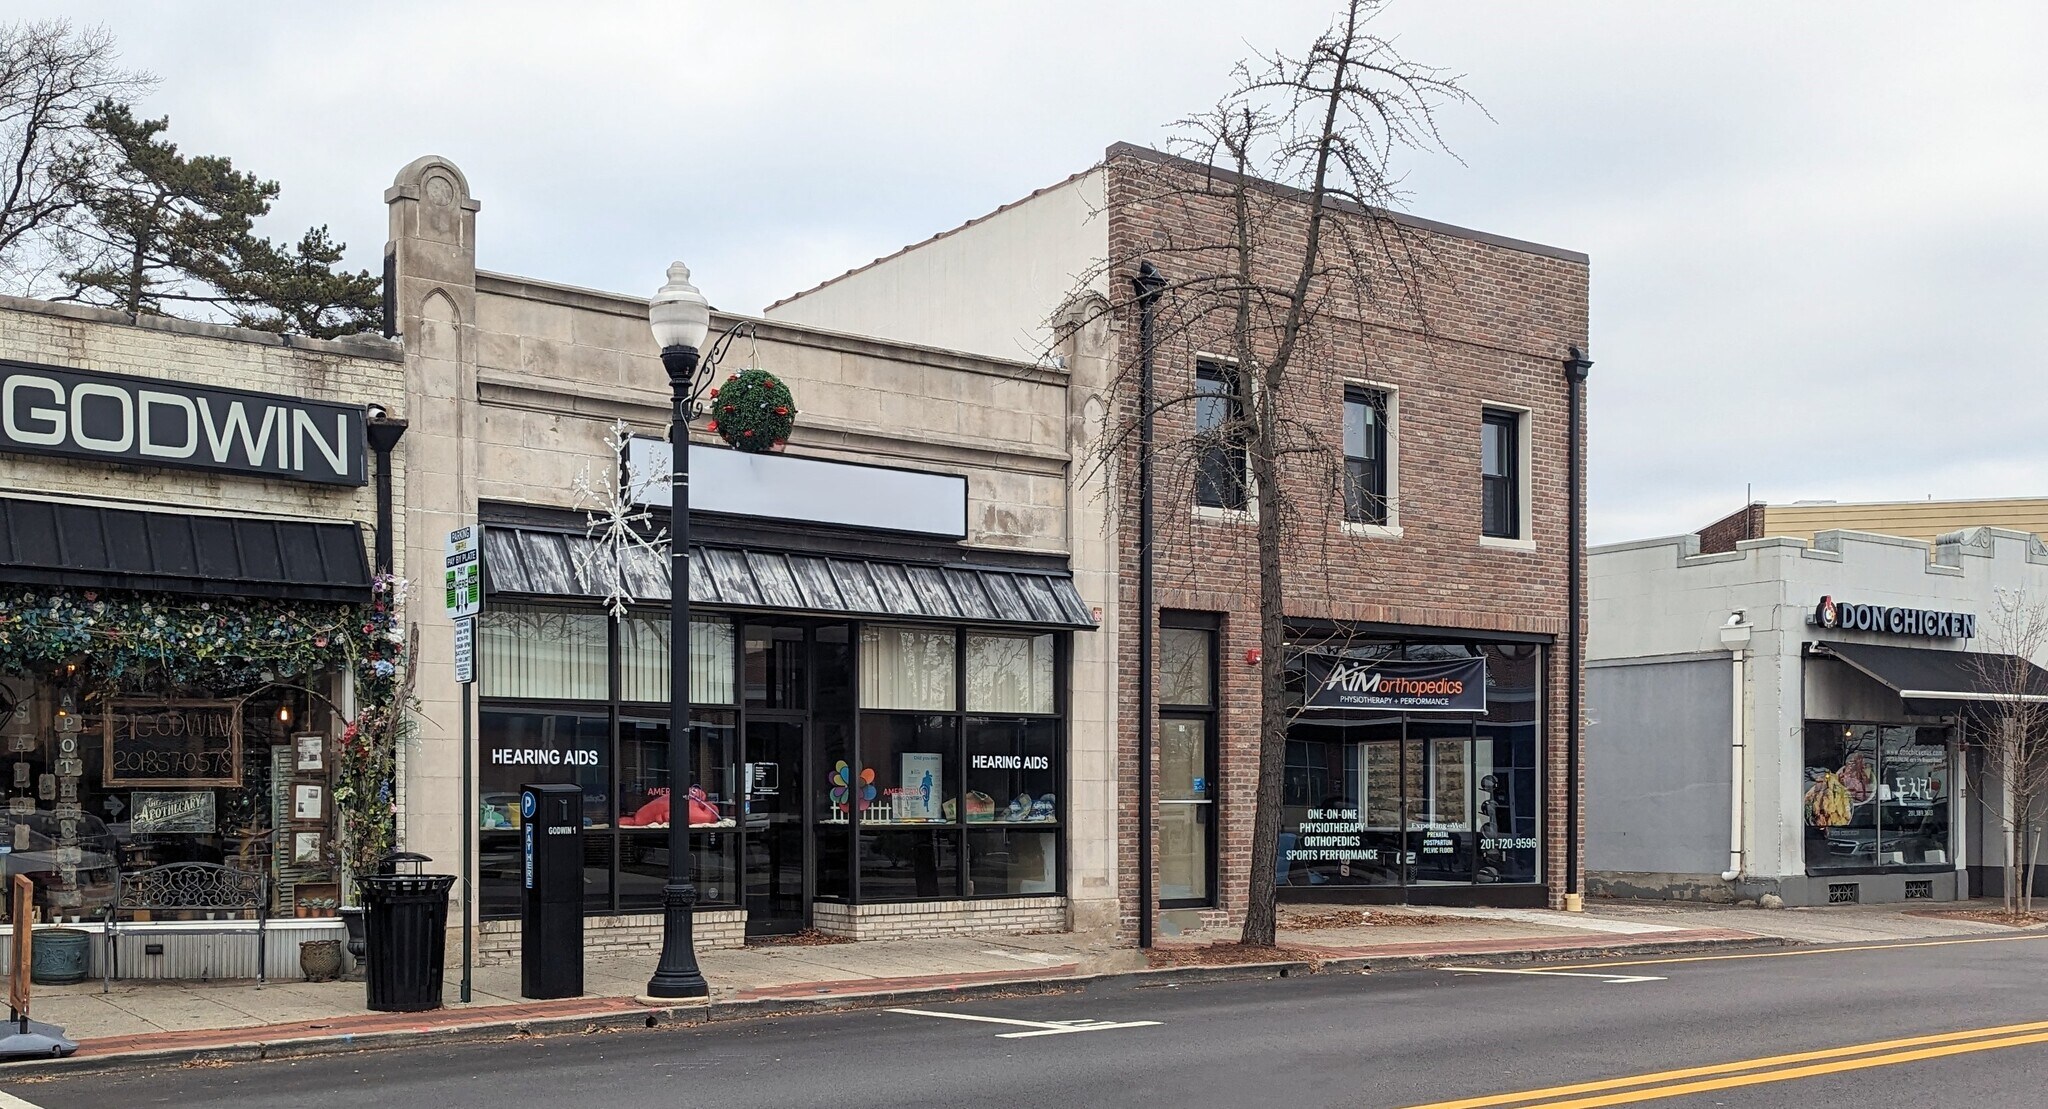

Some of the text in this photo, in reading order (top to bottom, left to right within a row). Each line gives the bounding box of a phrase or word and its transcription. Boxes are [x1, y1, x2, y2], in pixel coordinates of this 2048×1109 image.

[2, 374, 349, 477] GODWIN
[452, 528, 470, 542] PARKING
[447, 558, 455, 566] PAY
[462, 551, 476, 562] PLATE
[457, 566, 466, 576] PAY
[1842, 604, 1976, 638] DON CHICKEN
[1379, 678, 1463, 697] orthopedics
[1340, 696, 1393, 705] PHYSIOTHERAPY
[1400, 697, 1449, 706] PERFORMANCE
[136, 712, 229, 737] GODWIN
[492, 749, 599, 765] HEARING AIDS
[972, 755, 1048, 769] HEARING AIDS
[1892, 777, 1933, 806] 돈치킨
[1307, 809, 1358, 820] ONE-ON-ONE
[548, 826, 573, 835] GODWIN
[1299, 822, 1366, 833] PHYSIOTHERAPY
[1304, 836, 1361, 847] ORTHOPEDICS
[1480, 838, 1537, 850] 201-720-9596
[1286, 849, 1378, 861] SPORTS PERFORMANCE
